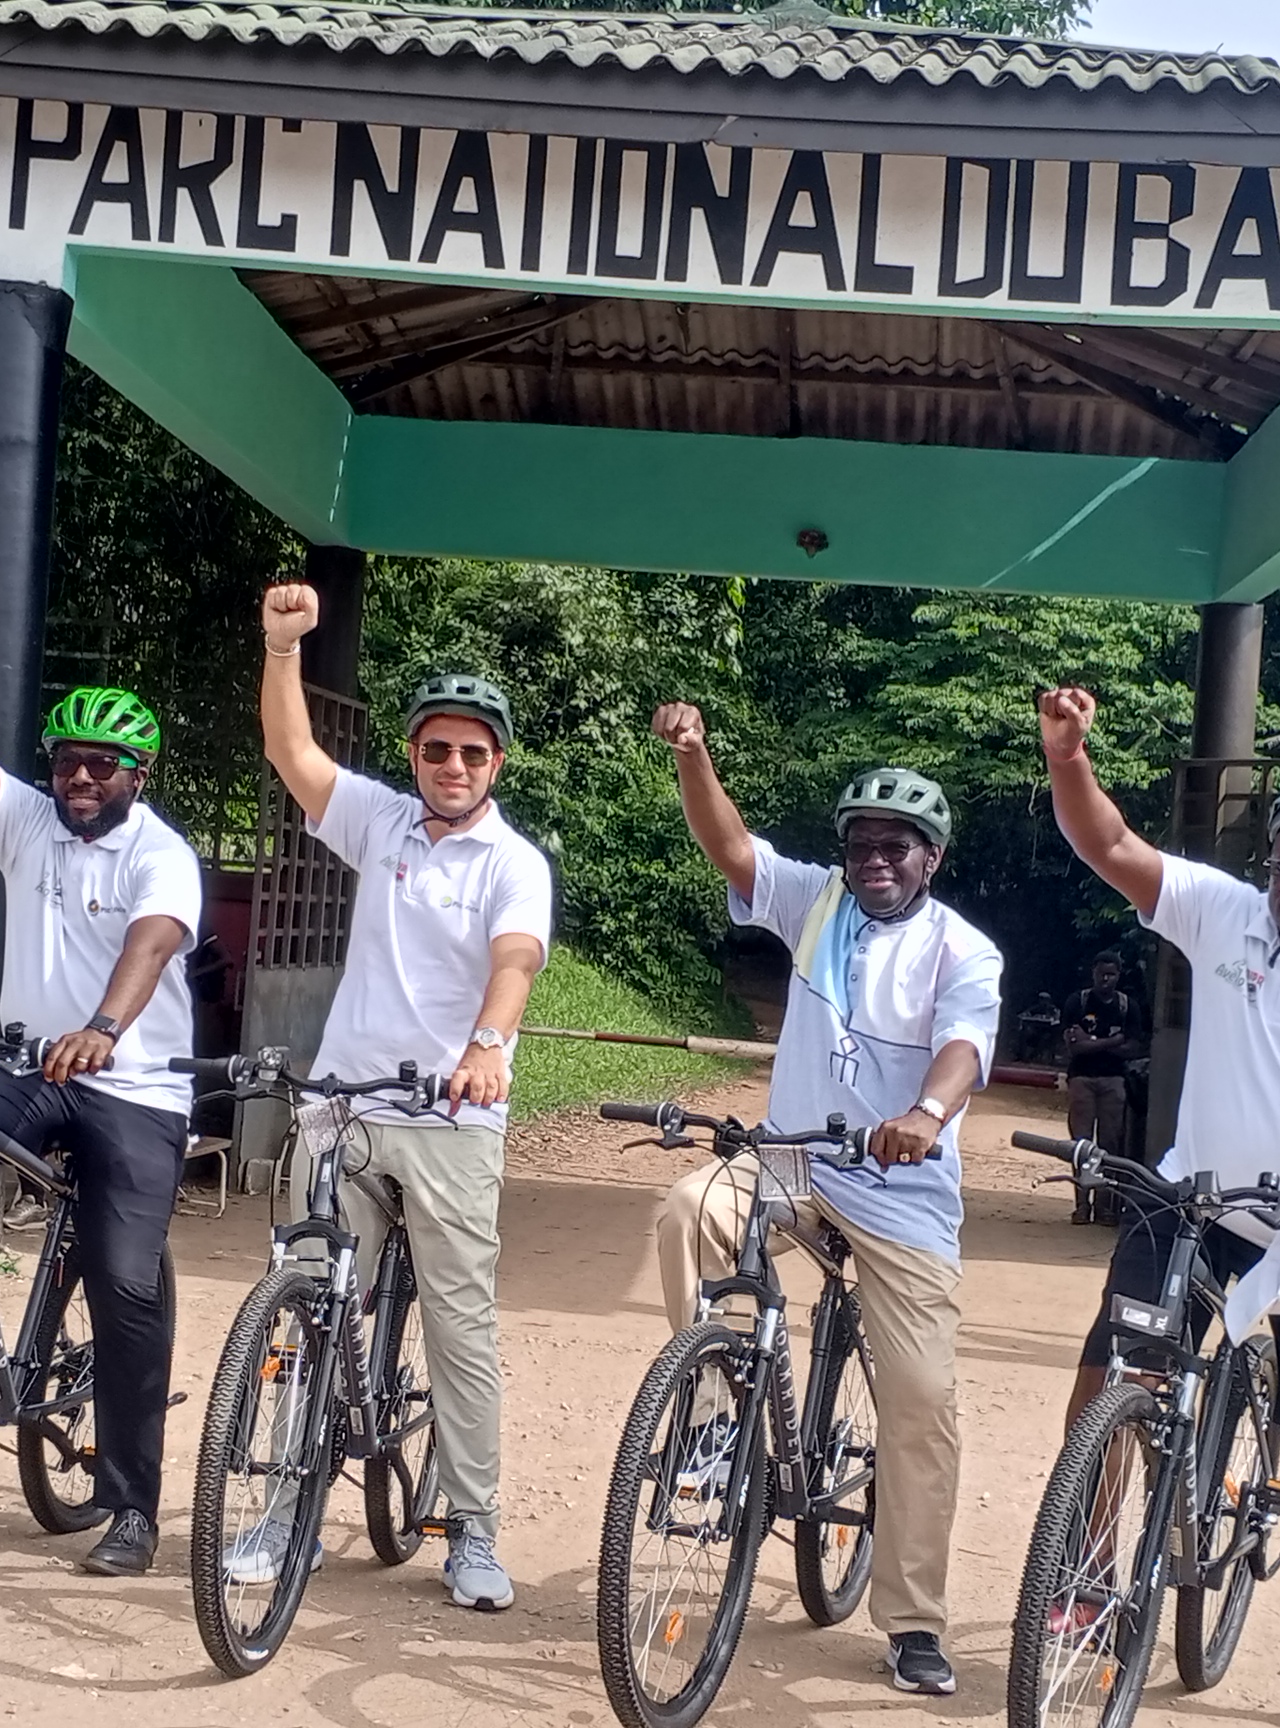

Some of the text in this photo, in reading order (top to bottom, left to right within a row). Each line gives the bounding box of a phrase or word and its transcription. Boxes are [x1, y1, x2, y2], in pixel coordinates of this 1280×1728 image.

[8, 98, 302, 253] PARC
[329, 121, 914, 295] NATIONAL
[937, 154, 1090, 304] DU
